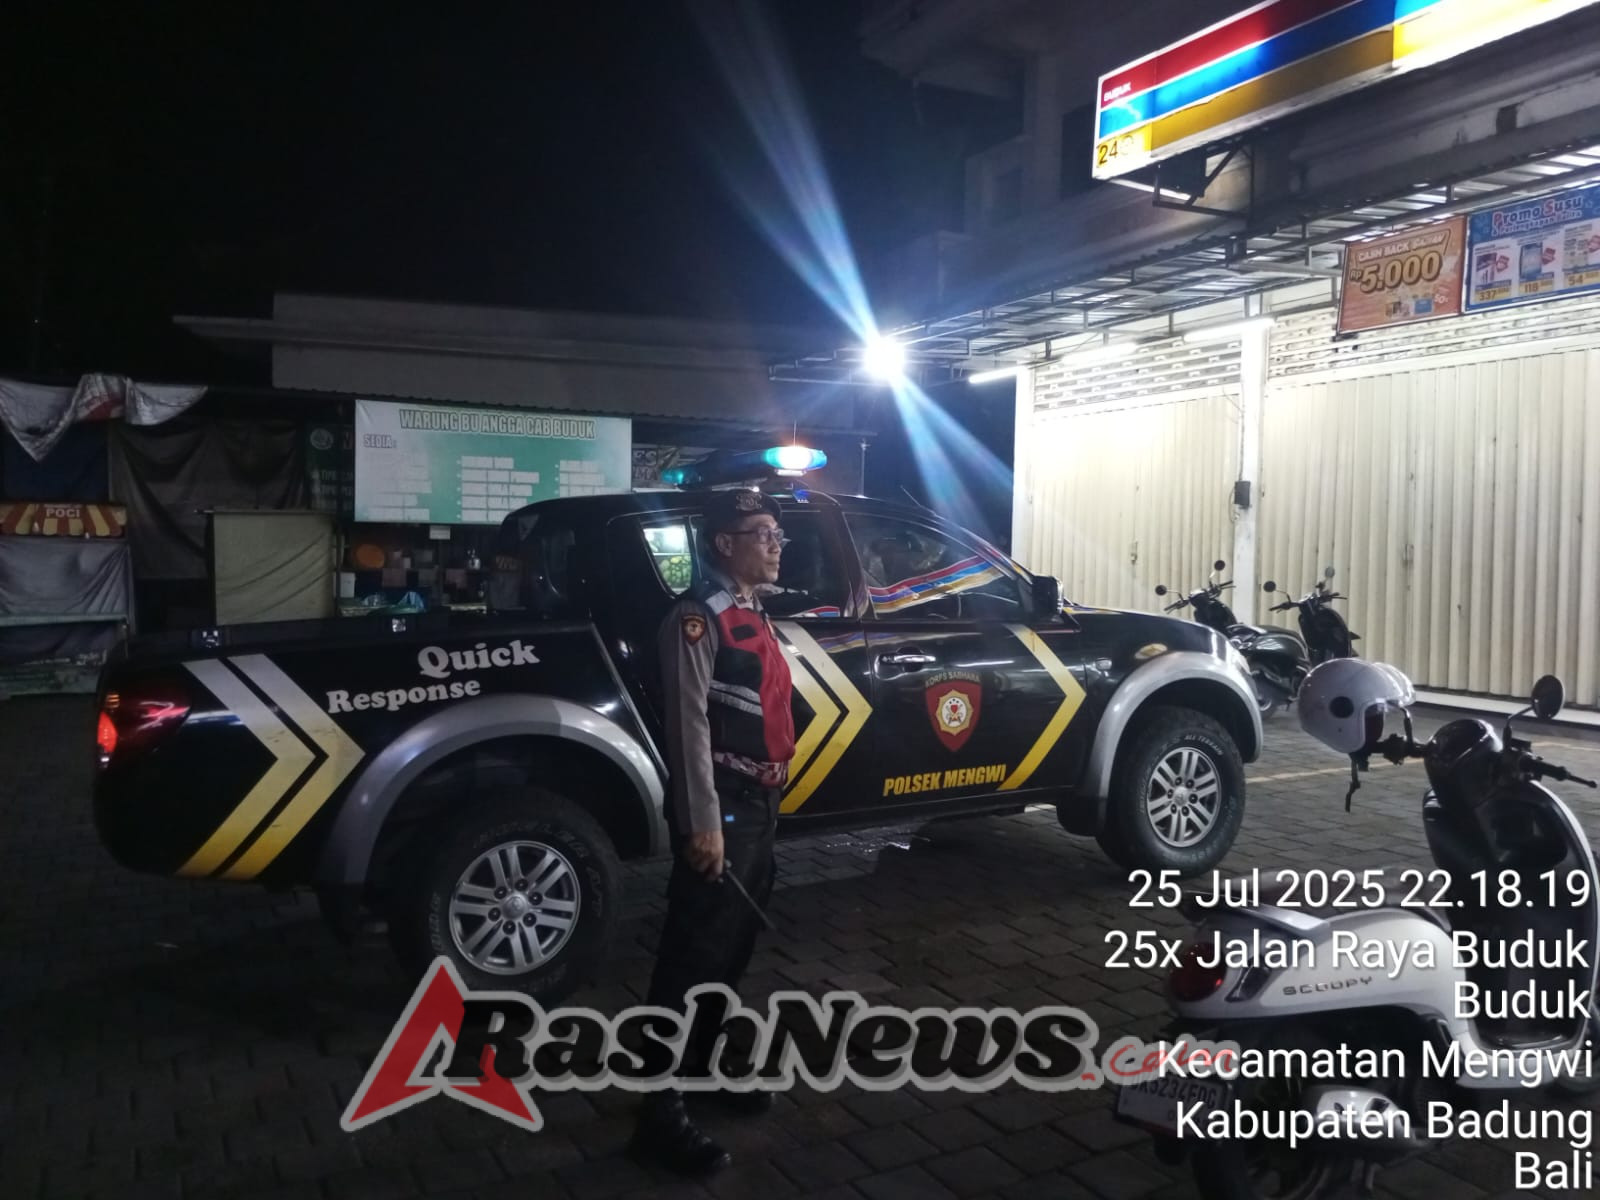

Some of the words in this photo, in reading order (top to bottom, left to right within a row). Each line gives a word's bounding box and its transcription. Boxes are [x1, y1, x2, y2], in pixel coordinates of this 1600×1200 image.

[1098, 140, 1118, 166] 24
[1493, 207, 1541, 227] Promo
[1543, 197, 1583, 215] Susu
[1358, 249, 1382, 262] CASH
[1383, 242, 1410, 257] BACK
[1361, 250, 1442, 293] 5.000
[400, 409, 459, 431] WARUNG
[460, 412, 479, 433] BU
[480, 414, 524, 435] ANGGA
[526, 416, 552, 437] CAB
[553, 418, 596, 439] BUDUK
[46, 508, 81, 518] POCI
[417, 639, 541, 679] Quick
[326, 679, 481, 714] Response
[883, 771, 942, 797] POLSEK
[943, 764, 1007, 789] MENGWI
[1282, 976, 1373, 996] SCOOPY
